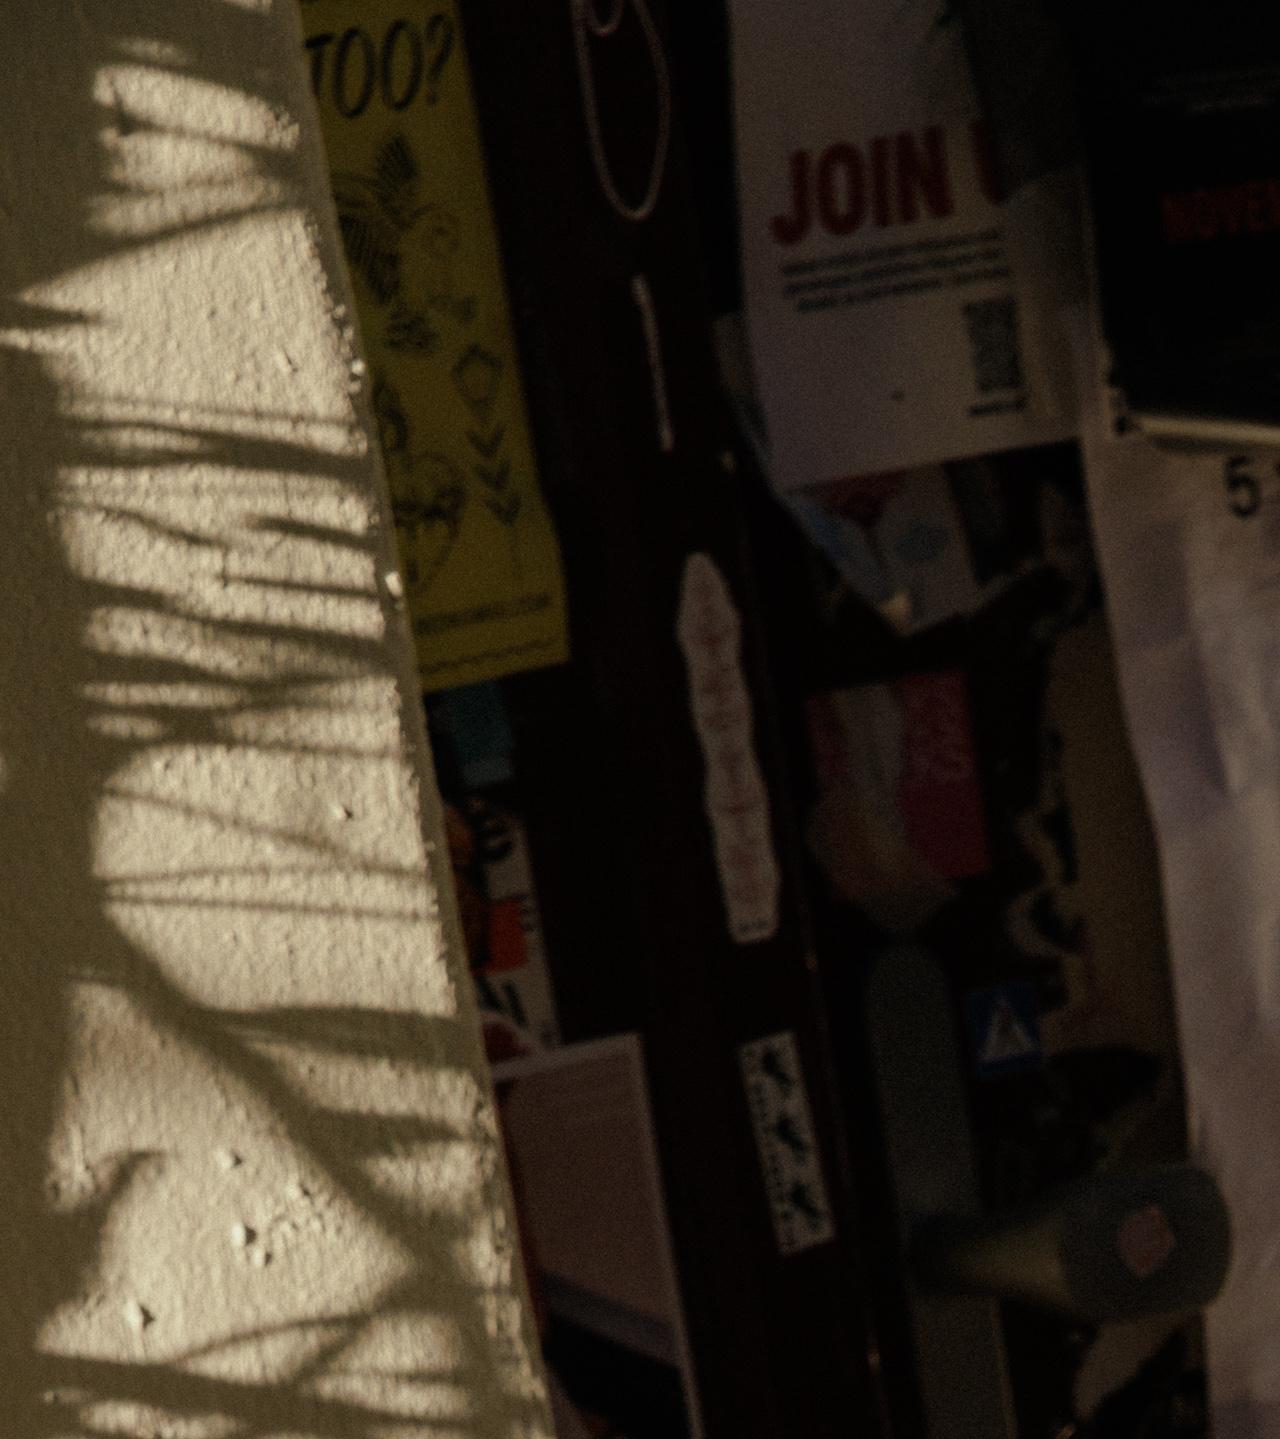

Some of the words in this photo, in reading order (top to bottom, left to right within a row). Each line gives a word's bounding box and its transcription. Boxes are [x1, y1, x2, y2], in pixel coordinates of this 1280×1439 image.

[304, 13, 453, 118] TOO?
[771, 126, 952, 246] JOIN
[1225, 455, 1260, 518] 5
